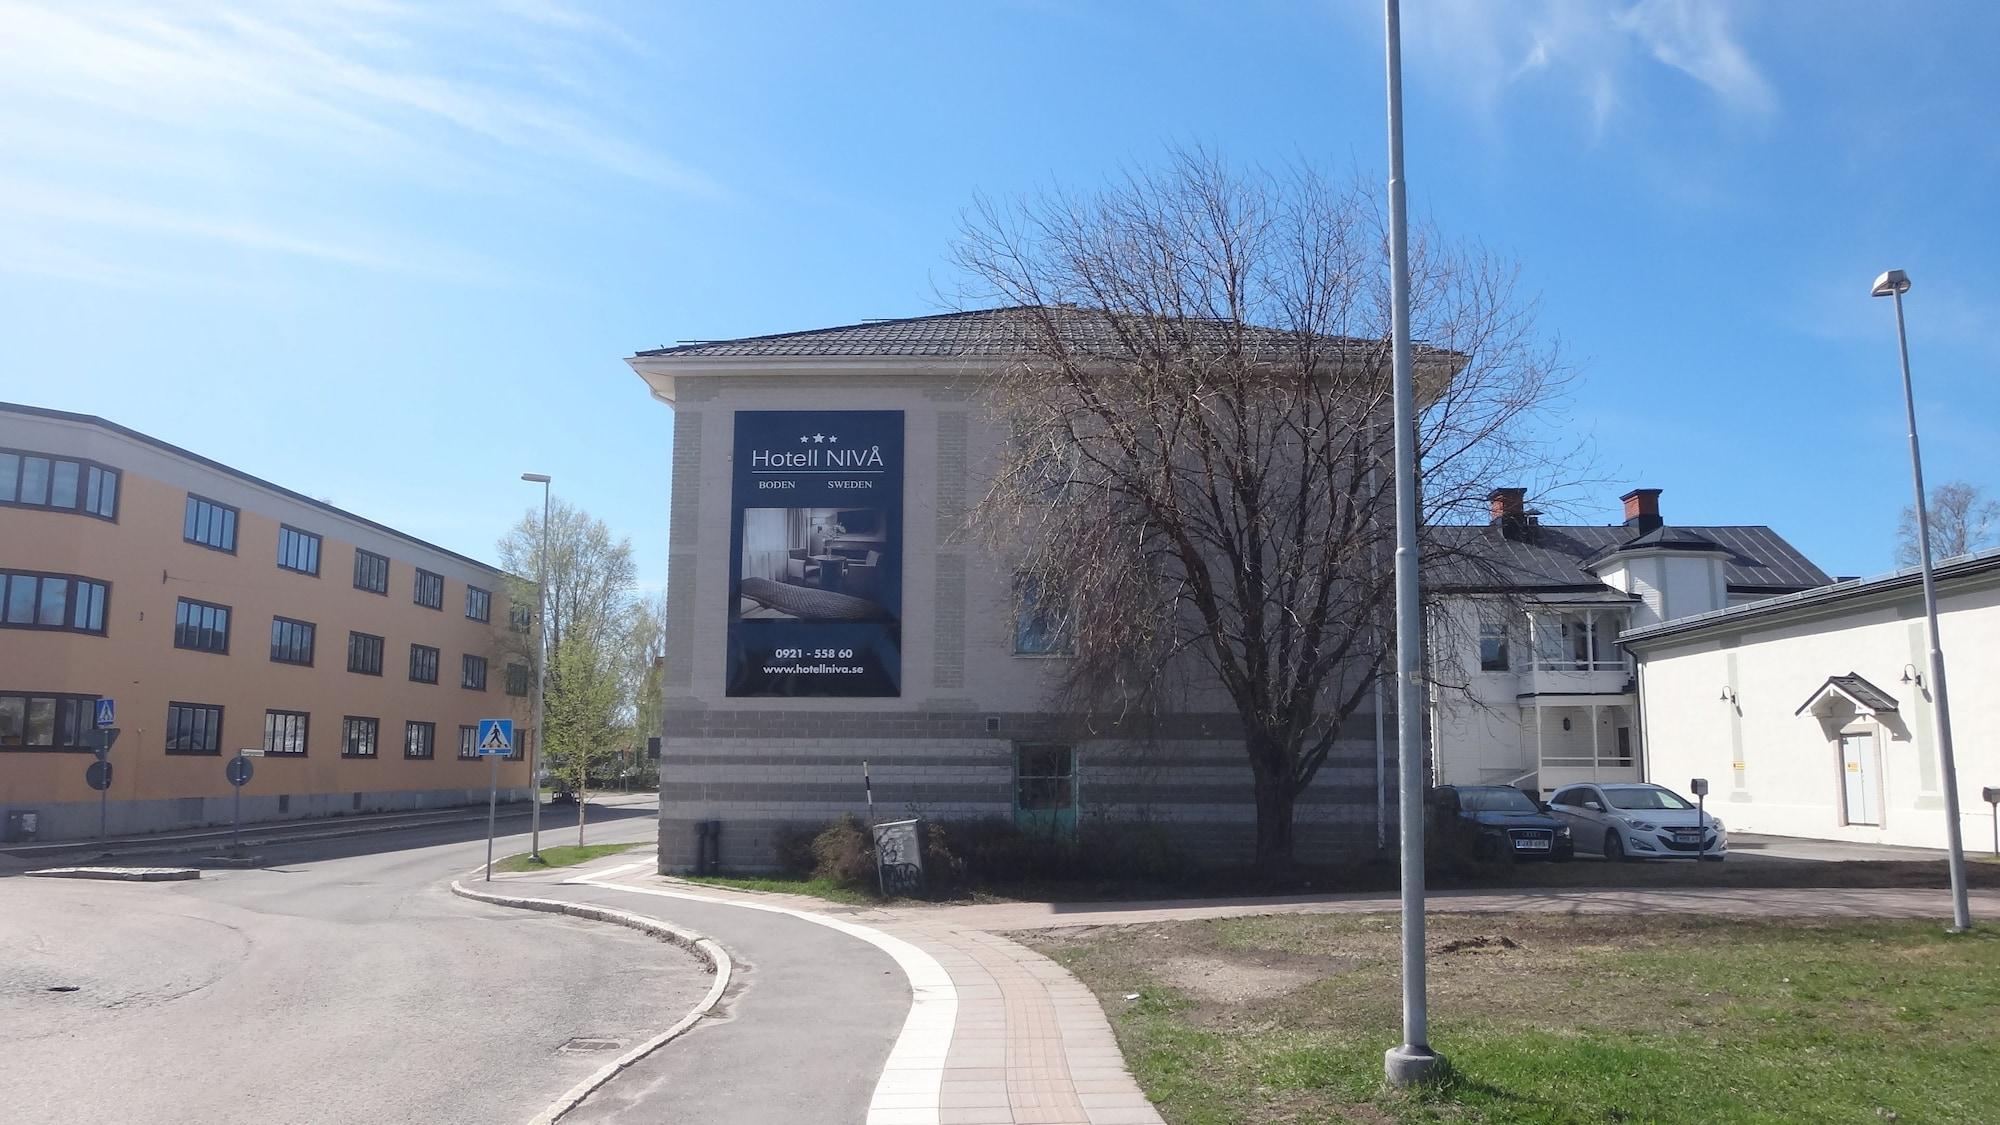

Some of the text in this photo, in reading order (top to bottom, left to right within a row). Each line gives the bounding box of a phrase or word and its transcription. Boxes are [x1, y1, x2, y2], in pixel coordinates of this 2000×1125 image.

[752, 445, 884, 467] Hotell NIVÅ
[759, 480, 873, 489] BODEN SWEDEN
[775, 649, 802, 659] 0921
[814, 649, 835, 659] 558
[838, 649, 853, 659] 60
[763, 664, 864, 674] www.hotellniva.se
